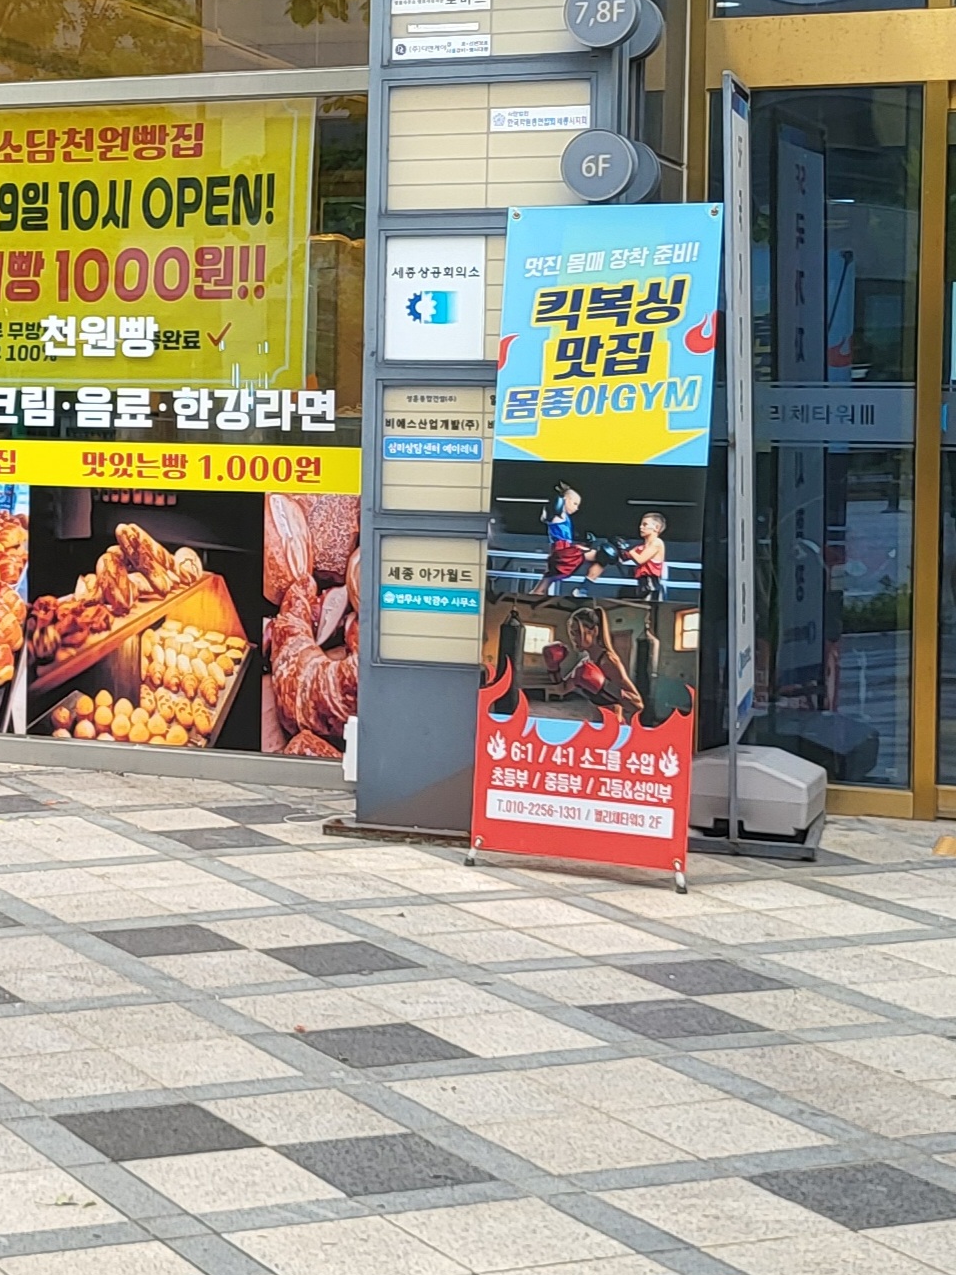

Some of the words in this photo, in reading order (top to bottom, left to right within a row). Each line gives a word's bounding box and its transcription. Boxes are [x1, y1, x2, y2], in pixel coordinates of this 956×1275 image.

[575, 0, 626, 27] 7,8F
[581, 154, 611, 177] 6F
[59, 180, 132, 231] 10시
[142, 172, 275, 229] OPEN!
[55, 245, 267, 302] 1000원!!
[392, 266, 480, 279] 세종상공회의소
[524, 256, 562, 278] 멋진
[566, 251, 605, 275] 몸매
[610, 246, 649, 270] 장착
[653, 241, 700, 265] 준비!
[534, 279, 687, 331] 킥복싱
[40, 315, 159, 358] 천원빵
[553, 331, 655, 380] 맛집
[81, 451, 189, 481] 맛있는빵
[197, 454, 322, 485] 1.000원
[388, 567, 414, 580] 세종
[419, 568, 473, 582] 아가월드
[510, 741, 533, 763] 6:1
[539, 746, 547, 763] /
[552, 746, 574, 766] 4:1
[579, 749, 621, 772] 소그룹
[626, 752, 655, 775] 수업
[491, 766, 529, 787] 초등부
[532, 772, 541, 789] /
[544, 772, 582, 794] 중등부
[586, 777, 595, 795] /
[597, 778, 673, 803] 고등&성인부
[649, 816, 663, 830] 2F
